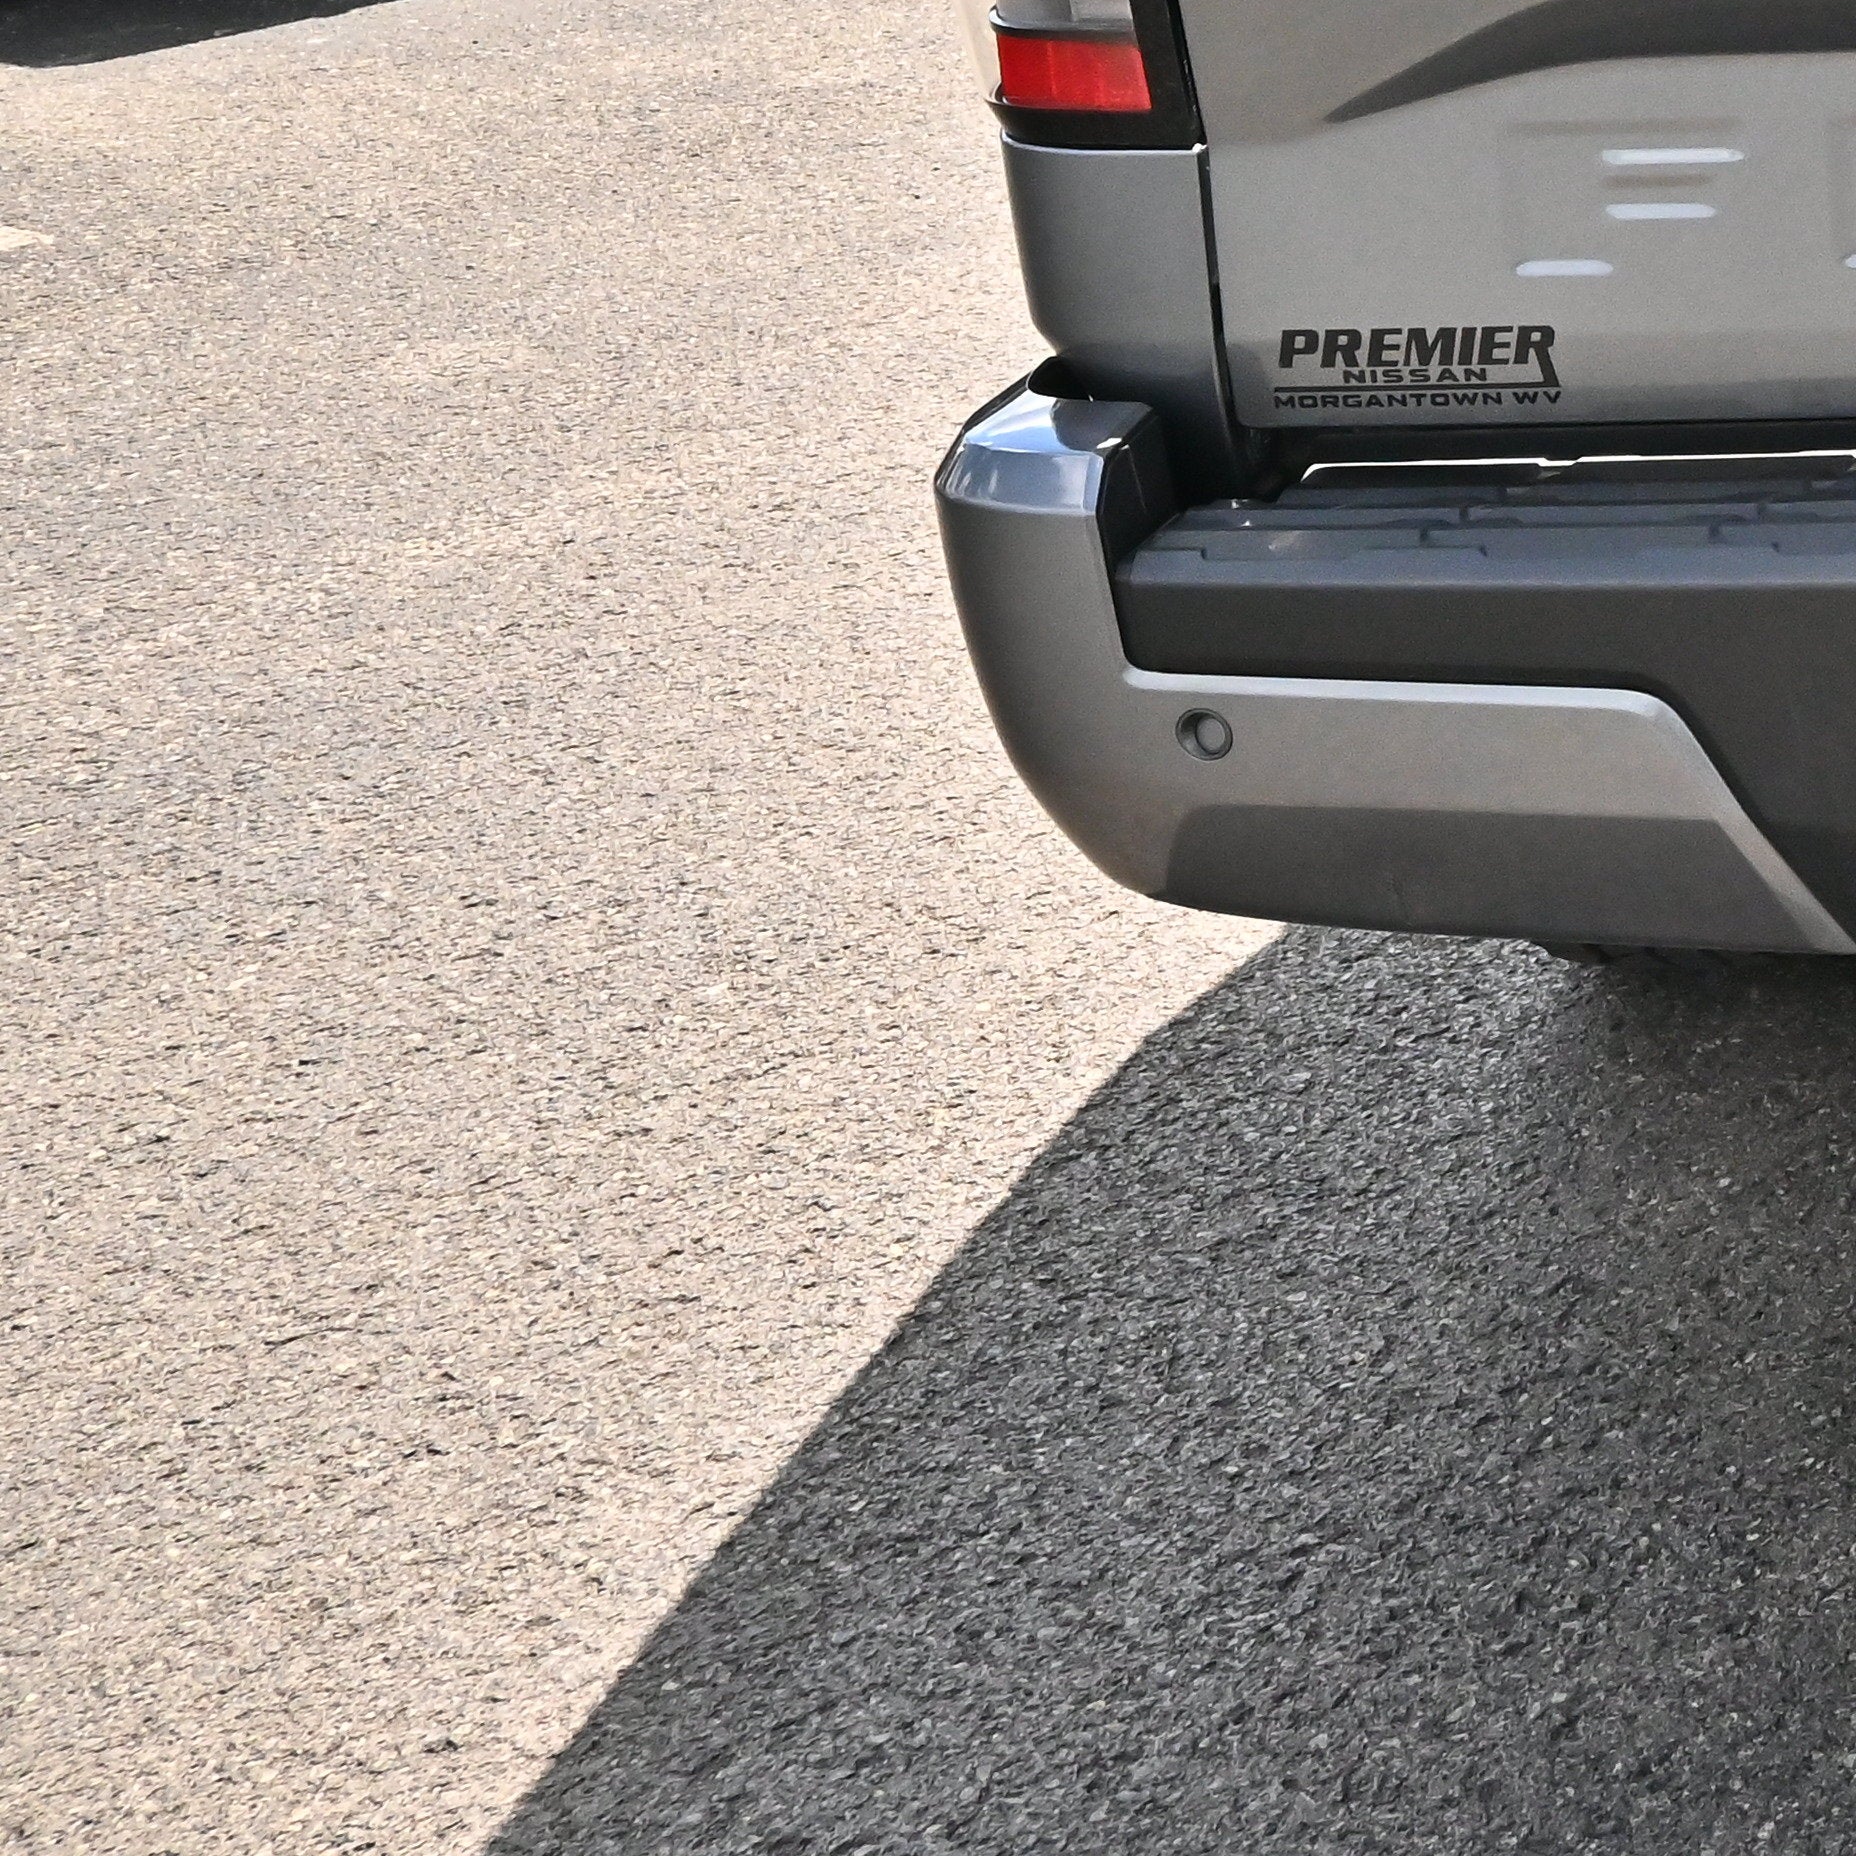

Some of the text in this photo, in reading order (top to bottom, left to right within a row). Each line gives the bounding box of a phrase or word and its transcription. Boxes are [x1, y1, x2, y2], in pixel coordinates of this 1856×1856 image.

[1278, 325, 1561, 389] PREMIER
[1342, 367, 1488, 384] NISSAN
[1274, 390, 1562, 410] MORGANTOWN WV
